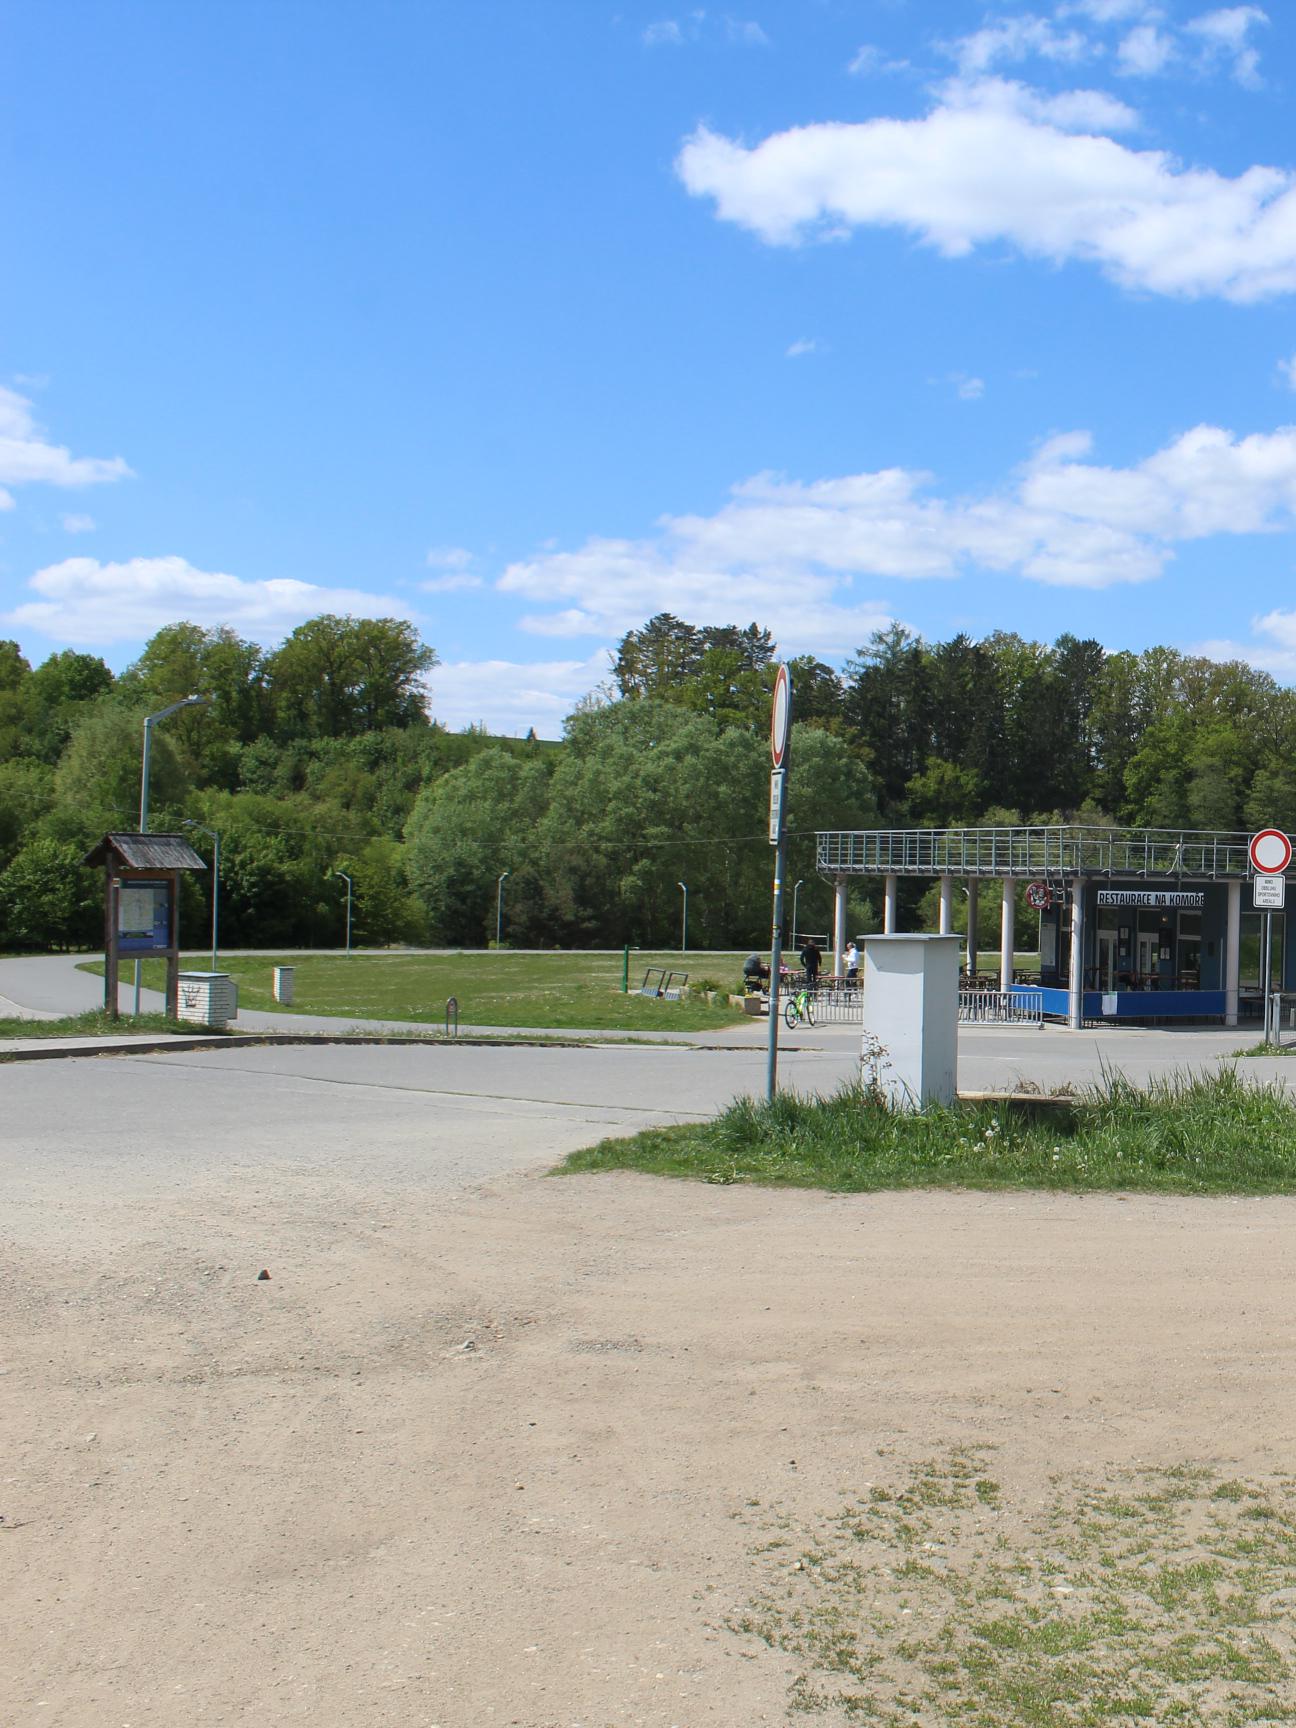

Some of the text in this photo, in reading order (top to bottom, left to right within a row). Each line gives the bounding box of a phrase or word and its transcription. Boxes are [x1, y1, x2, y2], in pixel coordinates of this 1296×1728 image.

[1099, 893, 1205, 906] RESTAURACE NA KOMOŘE
